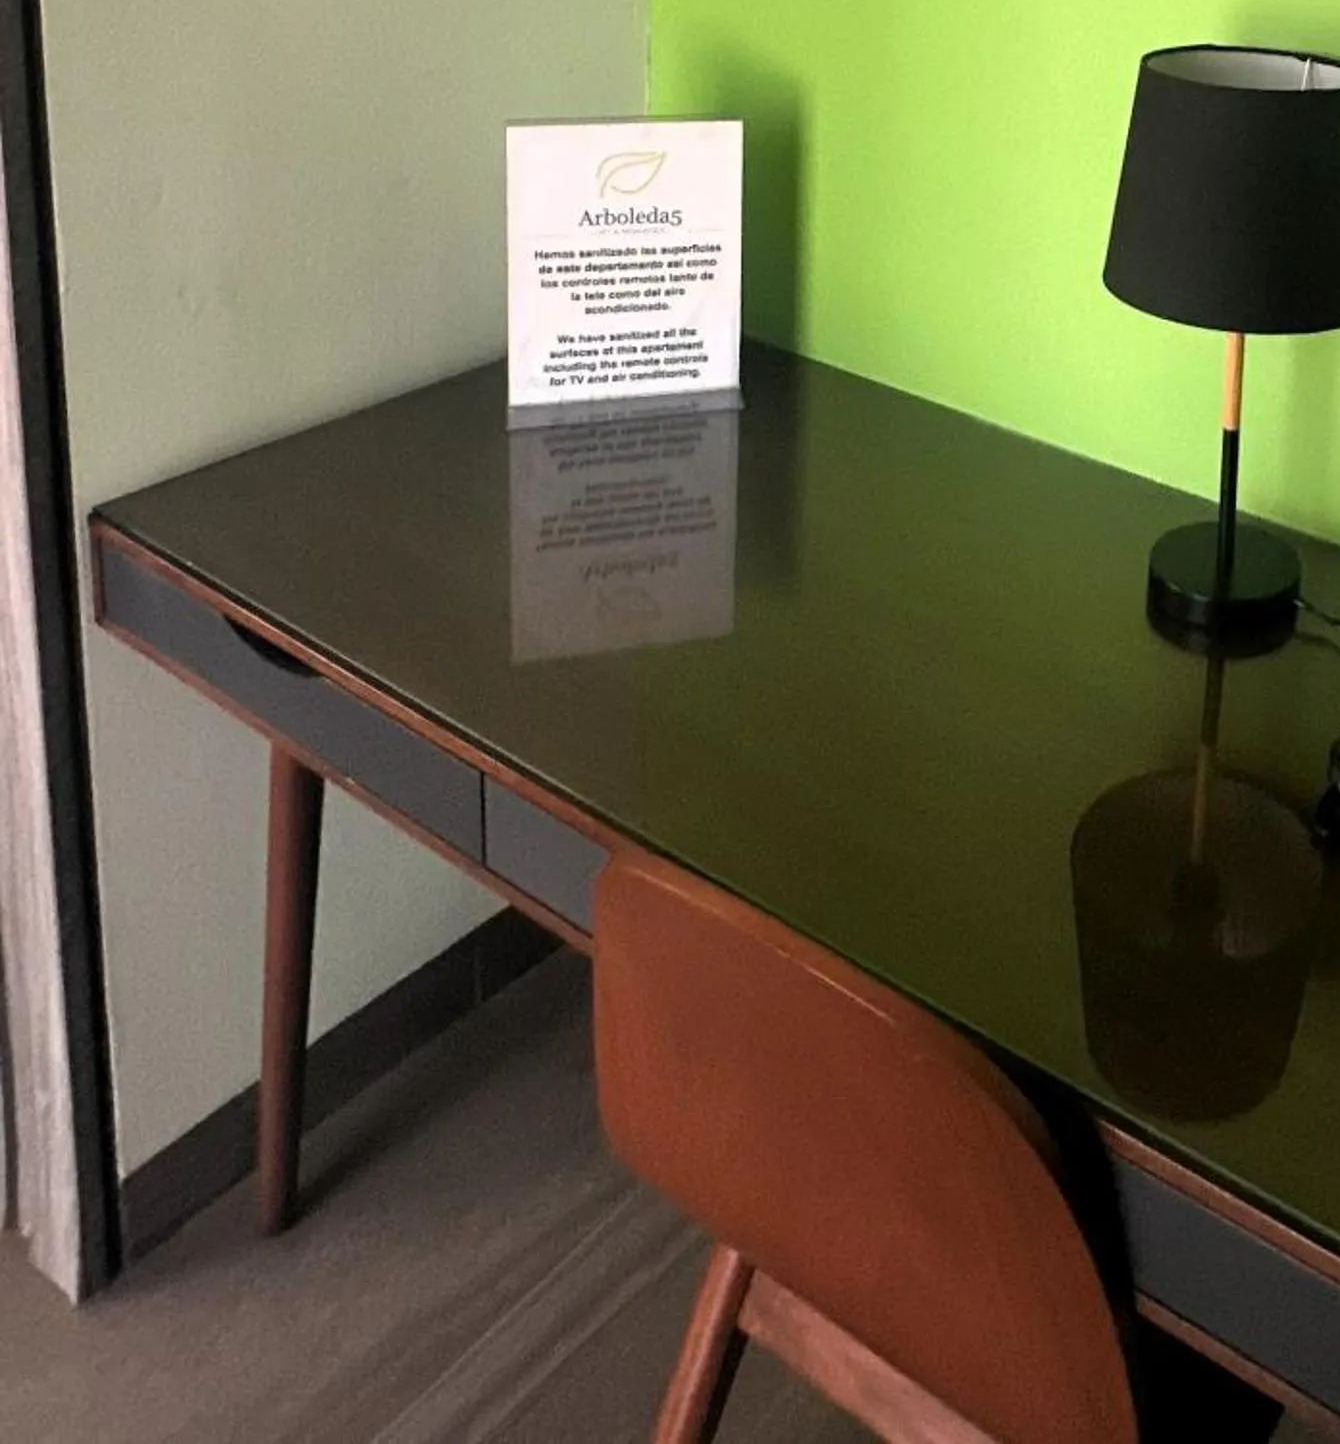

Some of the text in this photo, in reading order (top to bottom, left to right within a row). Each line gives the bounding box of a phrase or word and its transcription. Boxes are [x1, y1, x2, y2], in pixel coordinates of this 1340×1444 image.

[579, 206, 682, 227] Arboleda5
[535, 248, 575, 260] Hemos
[641, 246, 657, 256] las
[661, 243, 721, 256] superficies
[538, 264, 553, 274] de
[556, 264, 581, 274] este
[686, 259, 717, 268] como
[541, 278, 558, 288] los
[562, 276, 616, 287] controles
[619, 274, 666, 285] remotos
[700, 271, 714, 281] de
[571, 291, 580, 301] la
[608, 290, 640, 300] como
[643, 287, 661, 298] del
[664, 286, 685, 296] aire
[557, 327, 697, 344] We have sanitized all the
[549, 347, 600, 359] surfaces
[602, 346, 614, 356] of
[617, 344, 638, 355] this
[600, 359, 617, 369] the
[621, 356, 661, 368] remote
[663, 353, 709, 365] controls
[550, 376, 566, 387] for
[570, 374, 584, 385] TV
[587, 373, 609, 384] and
[612, 371, 627, 382] air
